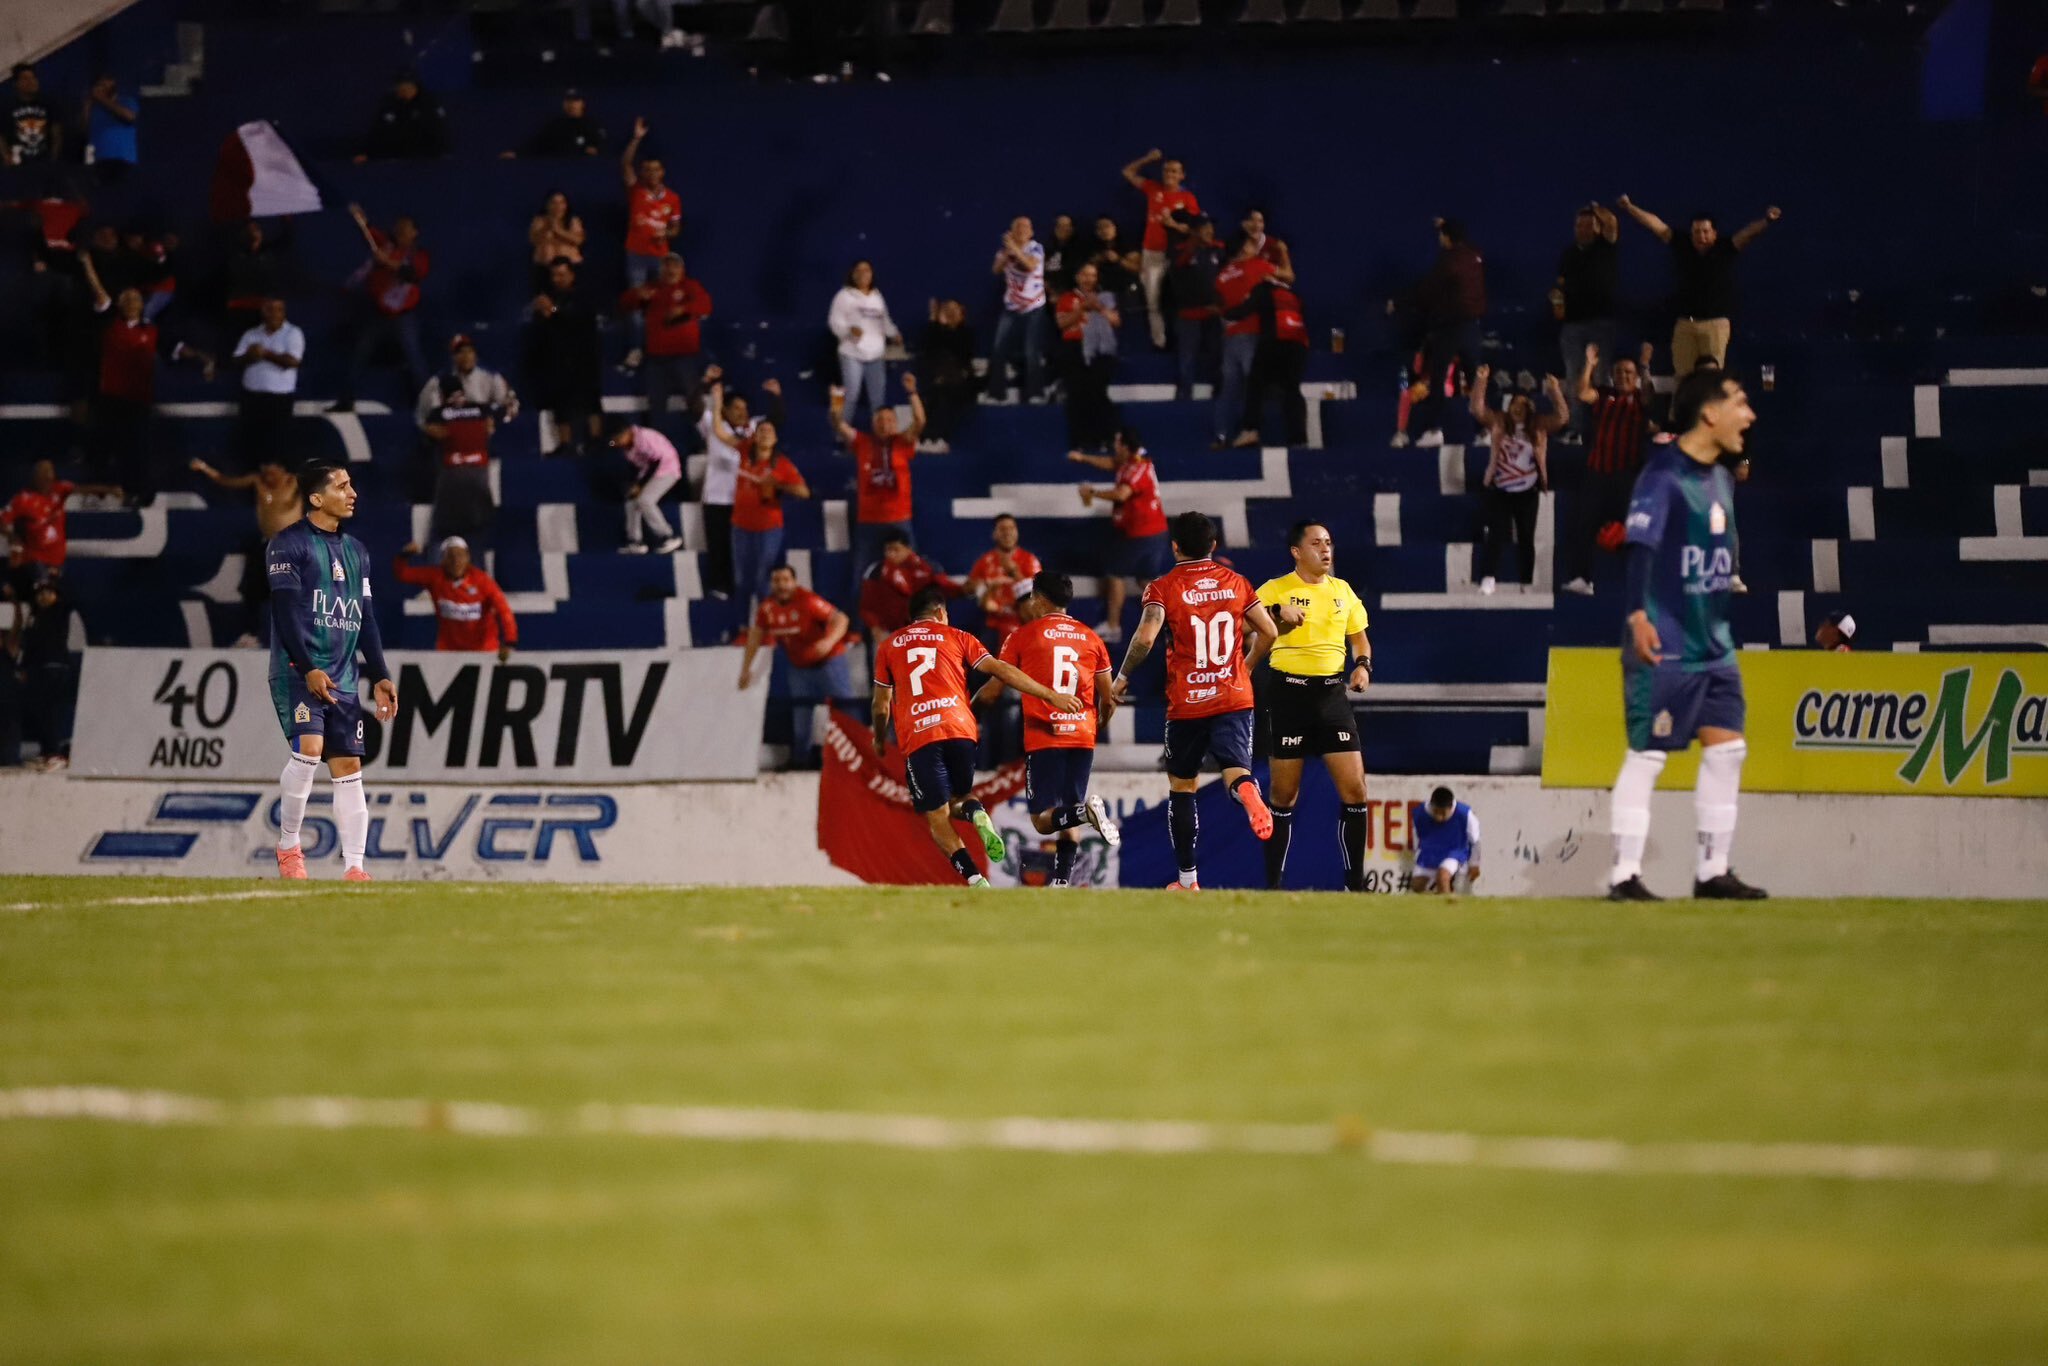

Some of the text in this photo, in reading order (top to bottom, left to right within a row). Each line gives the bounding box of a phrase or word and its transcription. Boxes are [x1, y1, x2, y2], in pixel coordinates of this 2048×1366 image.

[313, 589, 362, 618] PLAYA
[1182, 588, 1235, 606] Corona
[1290, 596, 1310, 607] FMF
[892, 633, 944, 648] Corona
[1043, 628, 1087, 641] Corona
[1190, 611, 1235, 668] 10
[907, 647, 937, 696] 7
[1052, 646, 1079, 699] 6
[1186, 664, 1233, 684] Comex
[153, 660, 238, 729] 40
[911, 695, 958, 716] Comex
[1049, 711, 1087, 721] Comex
[356, 720, 364, 739] 8
[150, 733, 225, 768] AÑOS
[1282, 736, 1303, 746] FMF
[253, 793, 617, 862] SLVER
